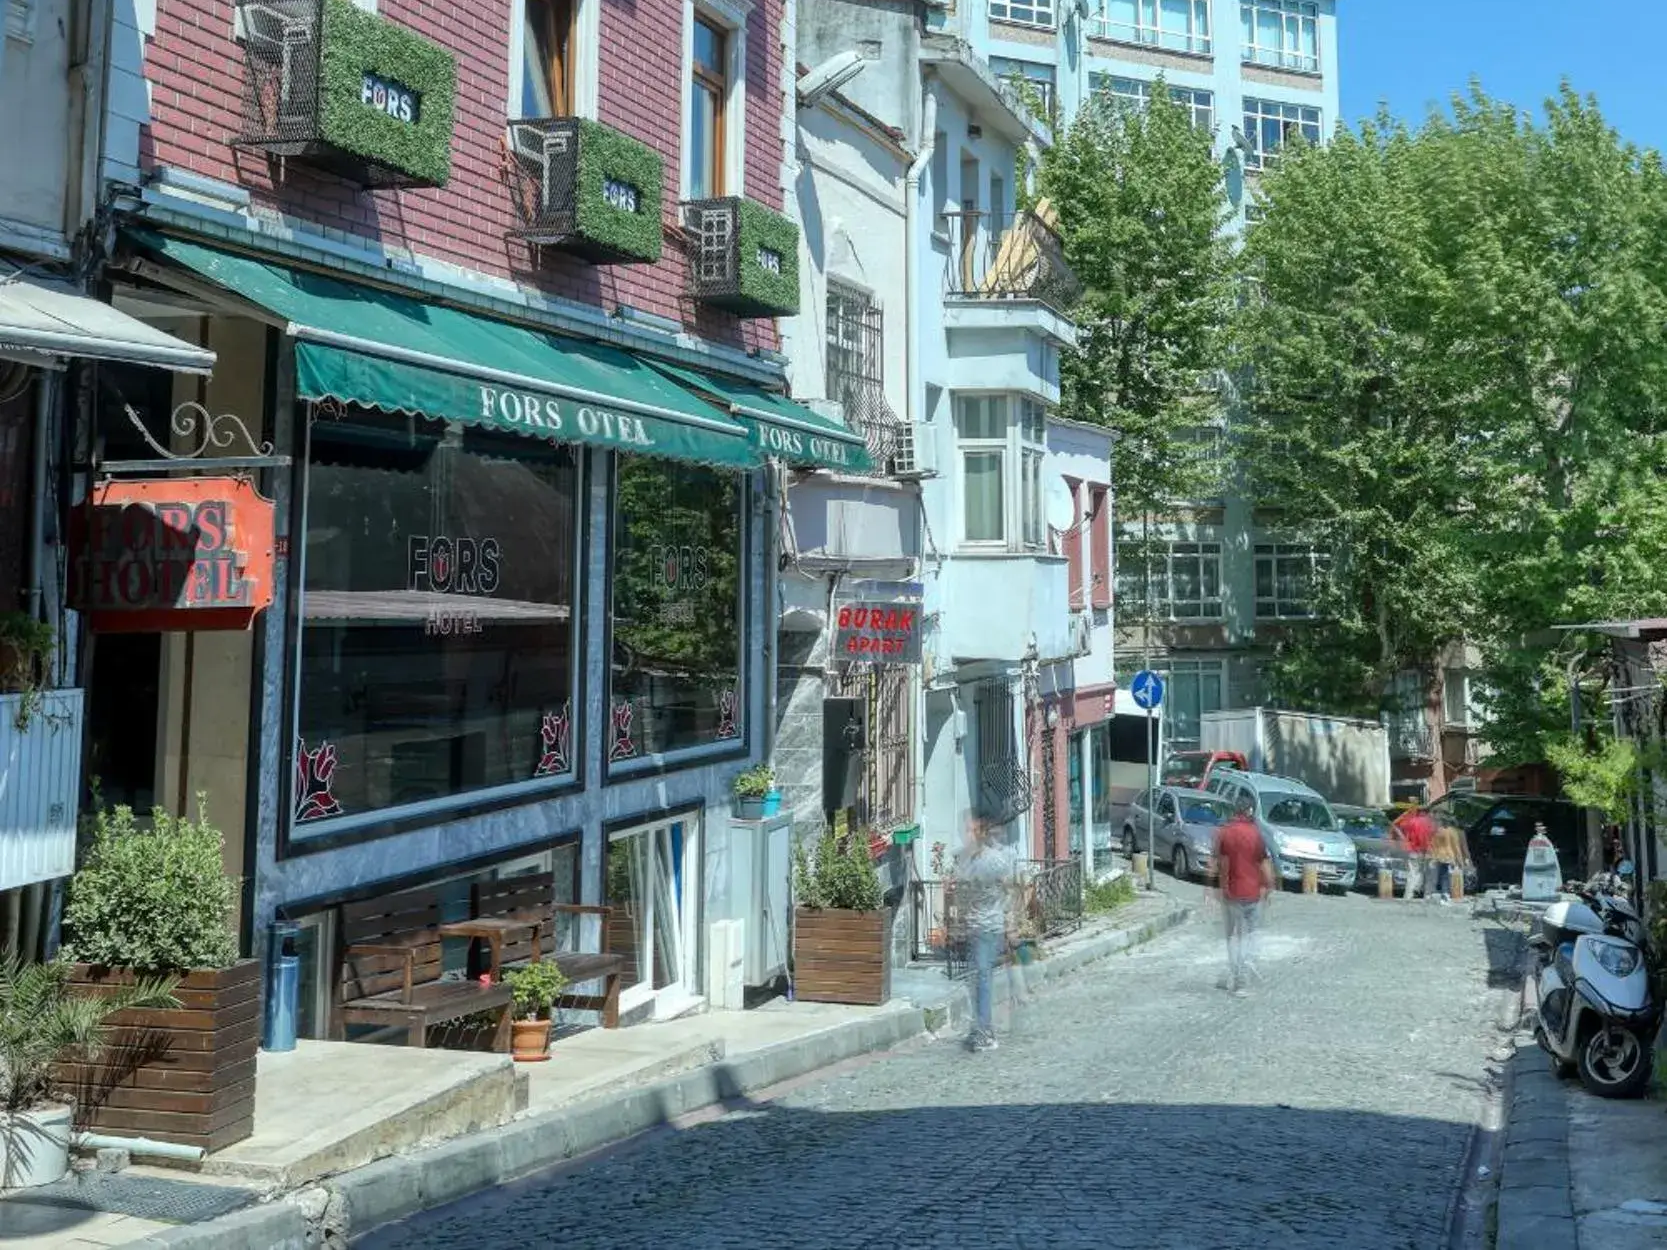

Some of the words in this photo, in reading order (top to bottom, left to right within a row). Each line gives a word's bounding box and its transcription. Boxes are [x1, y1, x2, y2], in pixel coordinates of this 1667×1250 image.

[361, 76, 412, 123] FORS
[602, 181, 636, 213] FORS
[480, 386, 563, 430] FORS
[578, 407, 655, 447] OTEL
[760, 424, 803, 456] FORS
[90, 501, 225, 552] FORS
[75, 557, 242, 605] HOTEL
[407, 535, 500, 593] FORS
[649, 544, 708, 591] FORS
[425, 610, 483, 636] HOTEL
[838, 607, 914, 632] BURAK
[847, 636, 905, 654] APART
